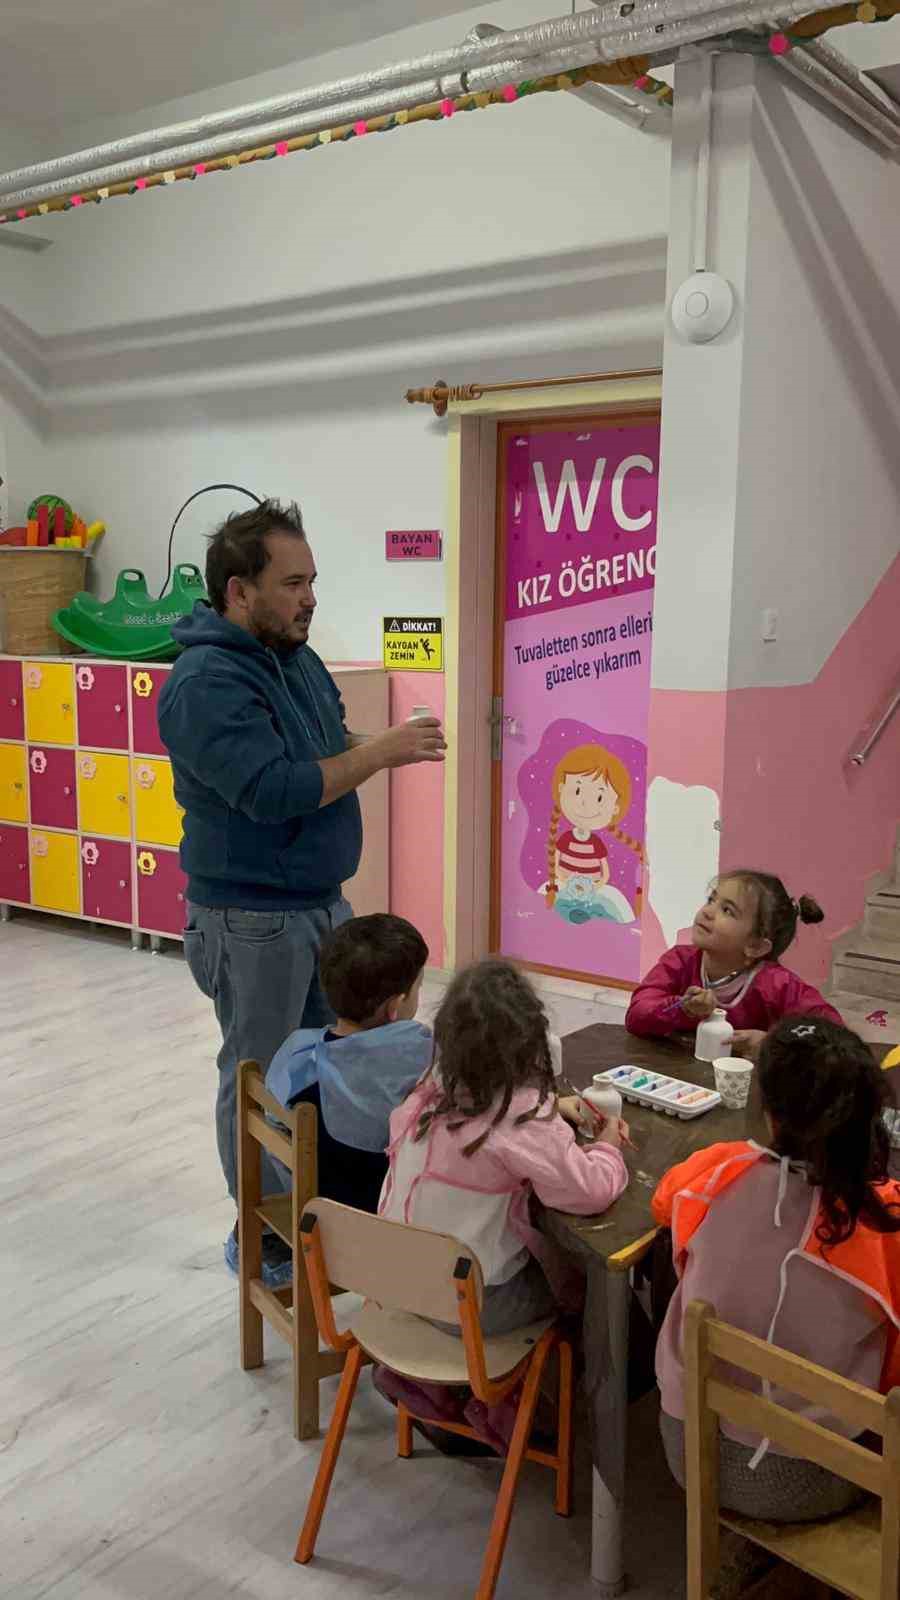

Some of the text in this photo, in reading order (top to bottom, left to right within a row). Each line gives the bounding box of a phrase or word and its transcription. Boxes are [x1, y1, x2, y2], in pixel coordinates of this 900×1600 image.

[532, 454, 654, 533] WC
[391, 533, 433, 545] BAYAN
[402, 545, 422, 556] WC
[517, 573, 553, 608] KIZ
[402, 619, 437, 632] DİKKAT!
[386, 639, 419, 650] KAYGAN
[514, 634, 579, 665] Tuvaletten
[581, 624, 617, 652] sonra
[390, 650, 415, 661] ZEMİN
[545, 648, 642, 690] güzelce yıkarım
